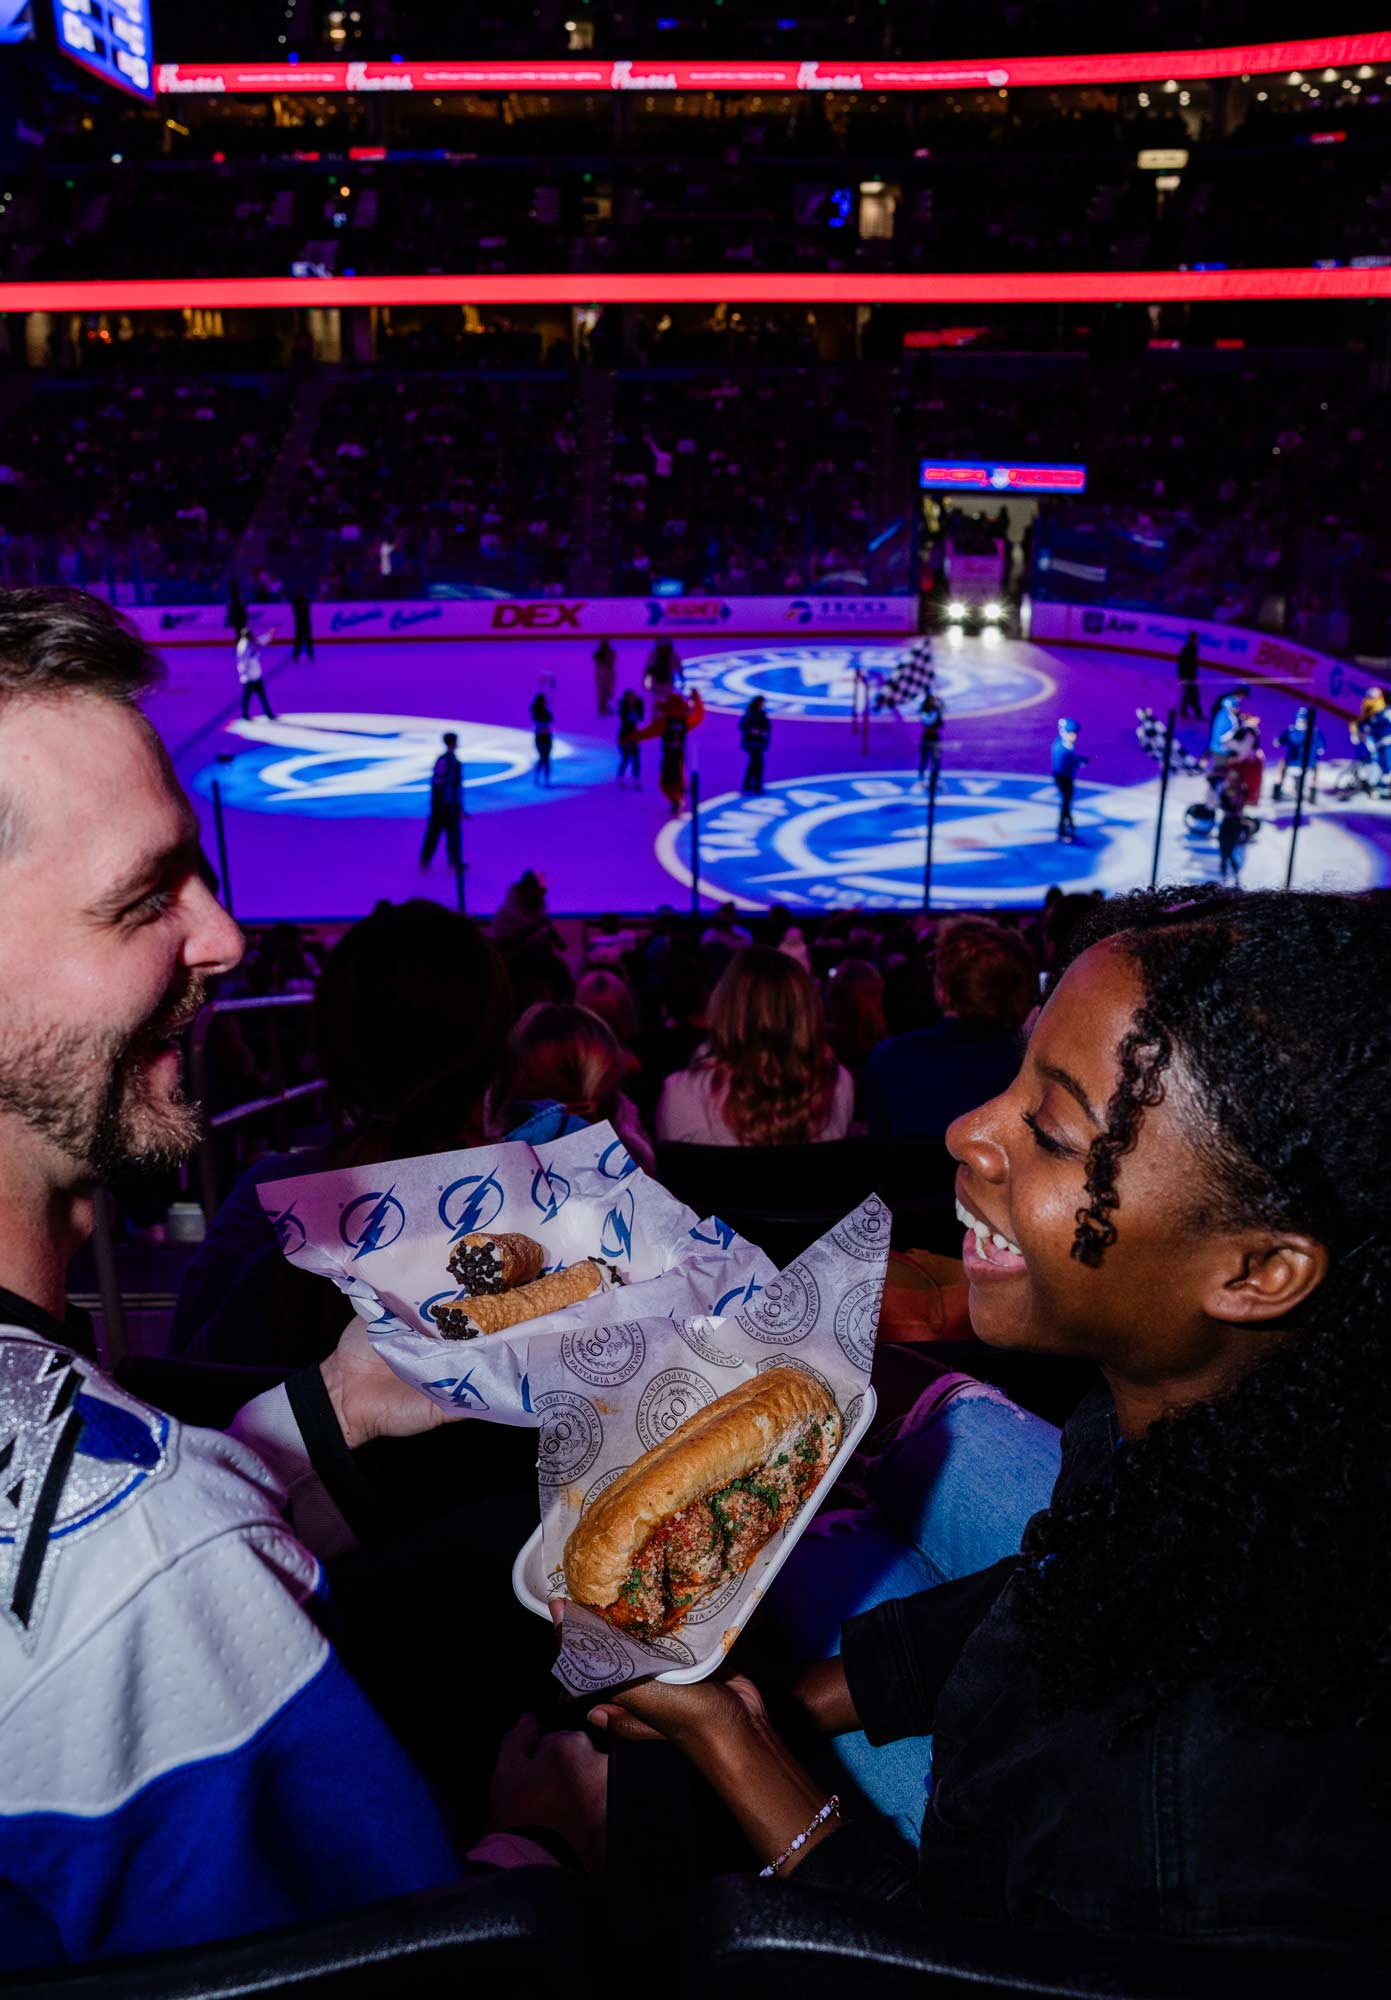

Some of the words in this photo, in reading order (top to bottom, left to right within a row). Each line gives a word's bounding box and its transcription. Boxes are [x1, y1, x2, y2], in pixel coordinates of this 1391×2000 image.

[491, 604, 584, 630] DEX
[835, 1232, 852, 1250] AND
[739, 1315, 754, 1333] AND
[755, 1331, 799, 1344] PASTARIA
[563, 1336, 571, 1359] AND
[568, 1360, 611, 1384] PASTARIA
[842, 1342, 860, 1363] AND
[535, 1394, 576, 1411] NAPOLT
[580, 1399, 599, 1430] PIZZA
[585, 1471, 621, 1506] OLTANA
[714, 1576, 742, 1610] VARO'S
